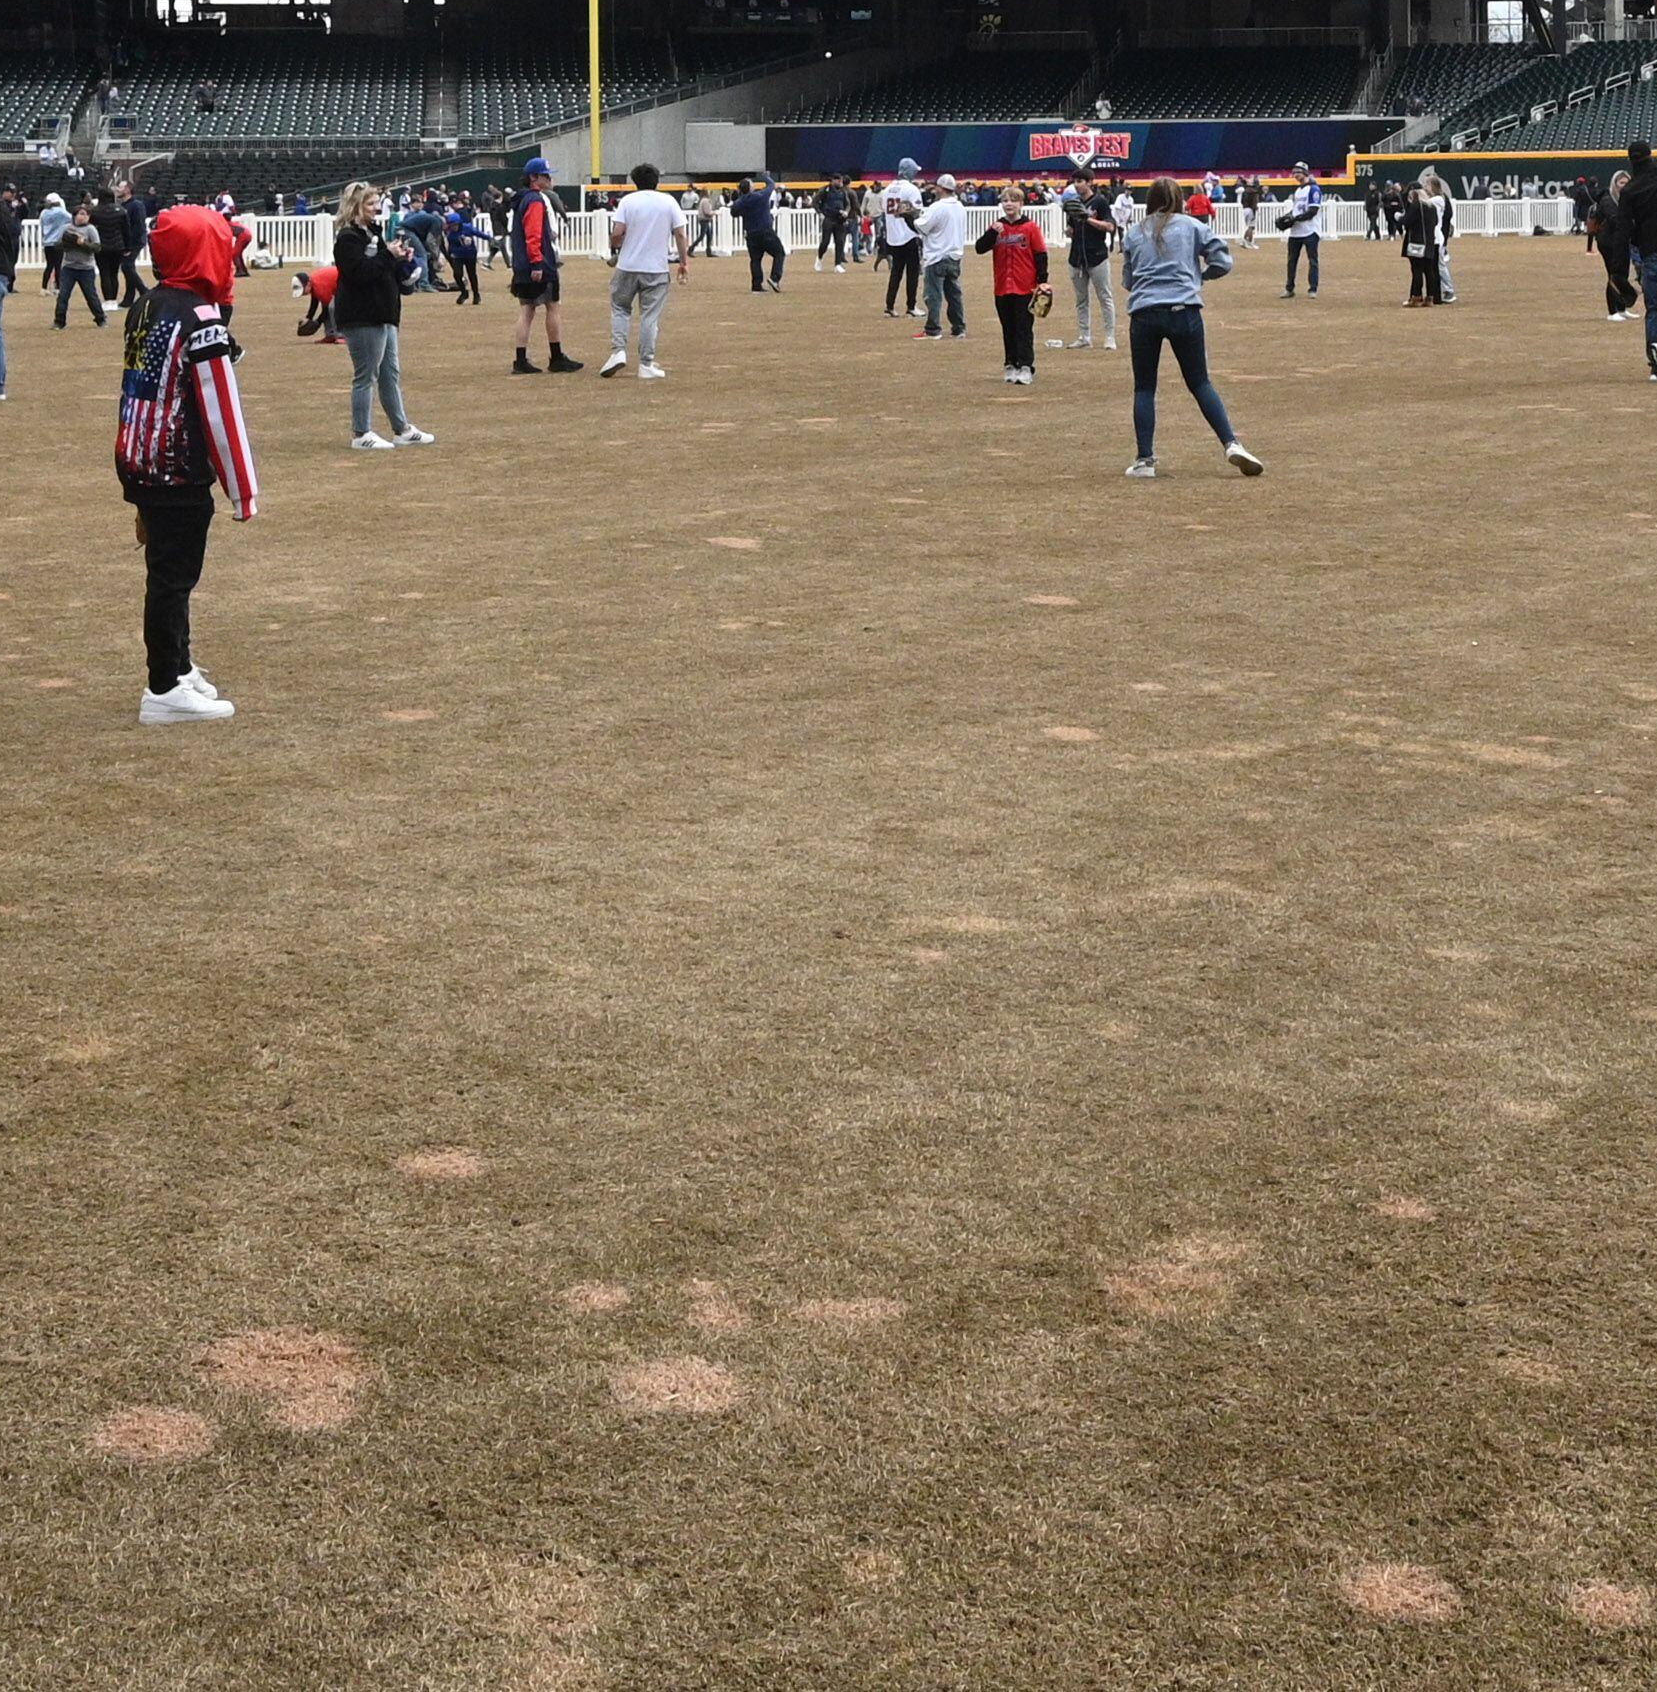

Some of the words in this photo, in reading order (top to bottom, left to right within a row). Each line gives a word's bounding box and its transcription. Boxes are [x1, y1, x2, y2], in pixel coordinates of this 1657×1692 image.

[1030, 133, 1091, 160] BRAVES
[1094, 132, 1132, 159] FEST
[1355, 164, 1373, 177] 375
[1461, 174, 1574, 200] Welltar
